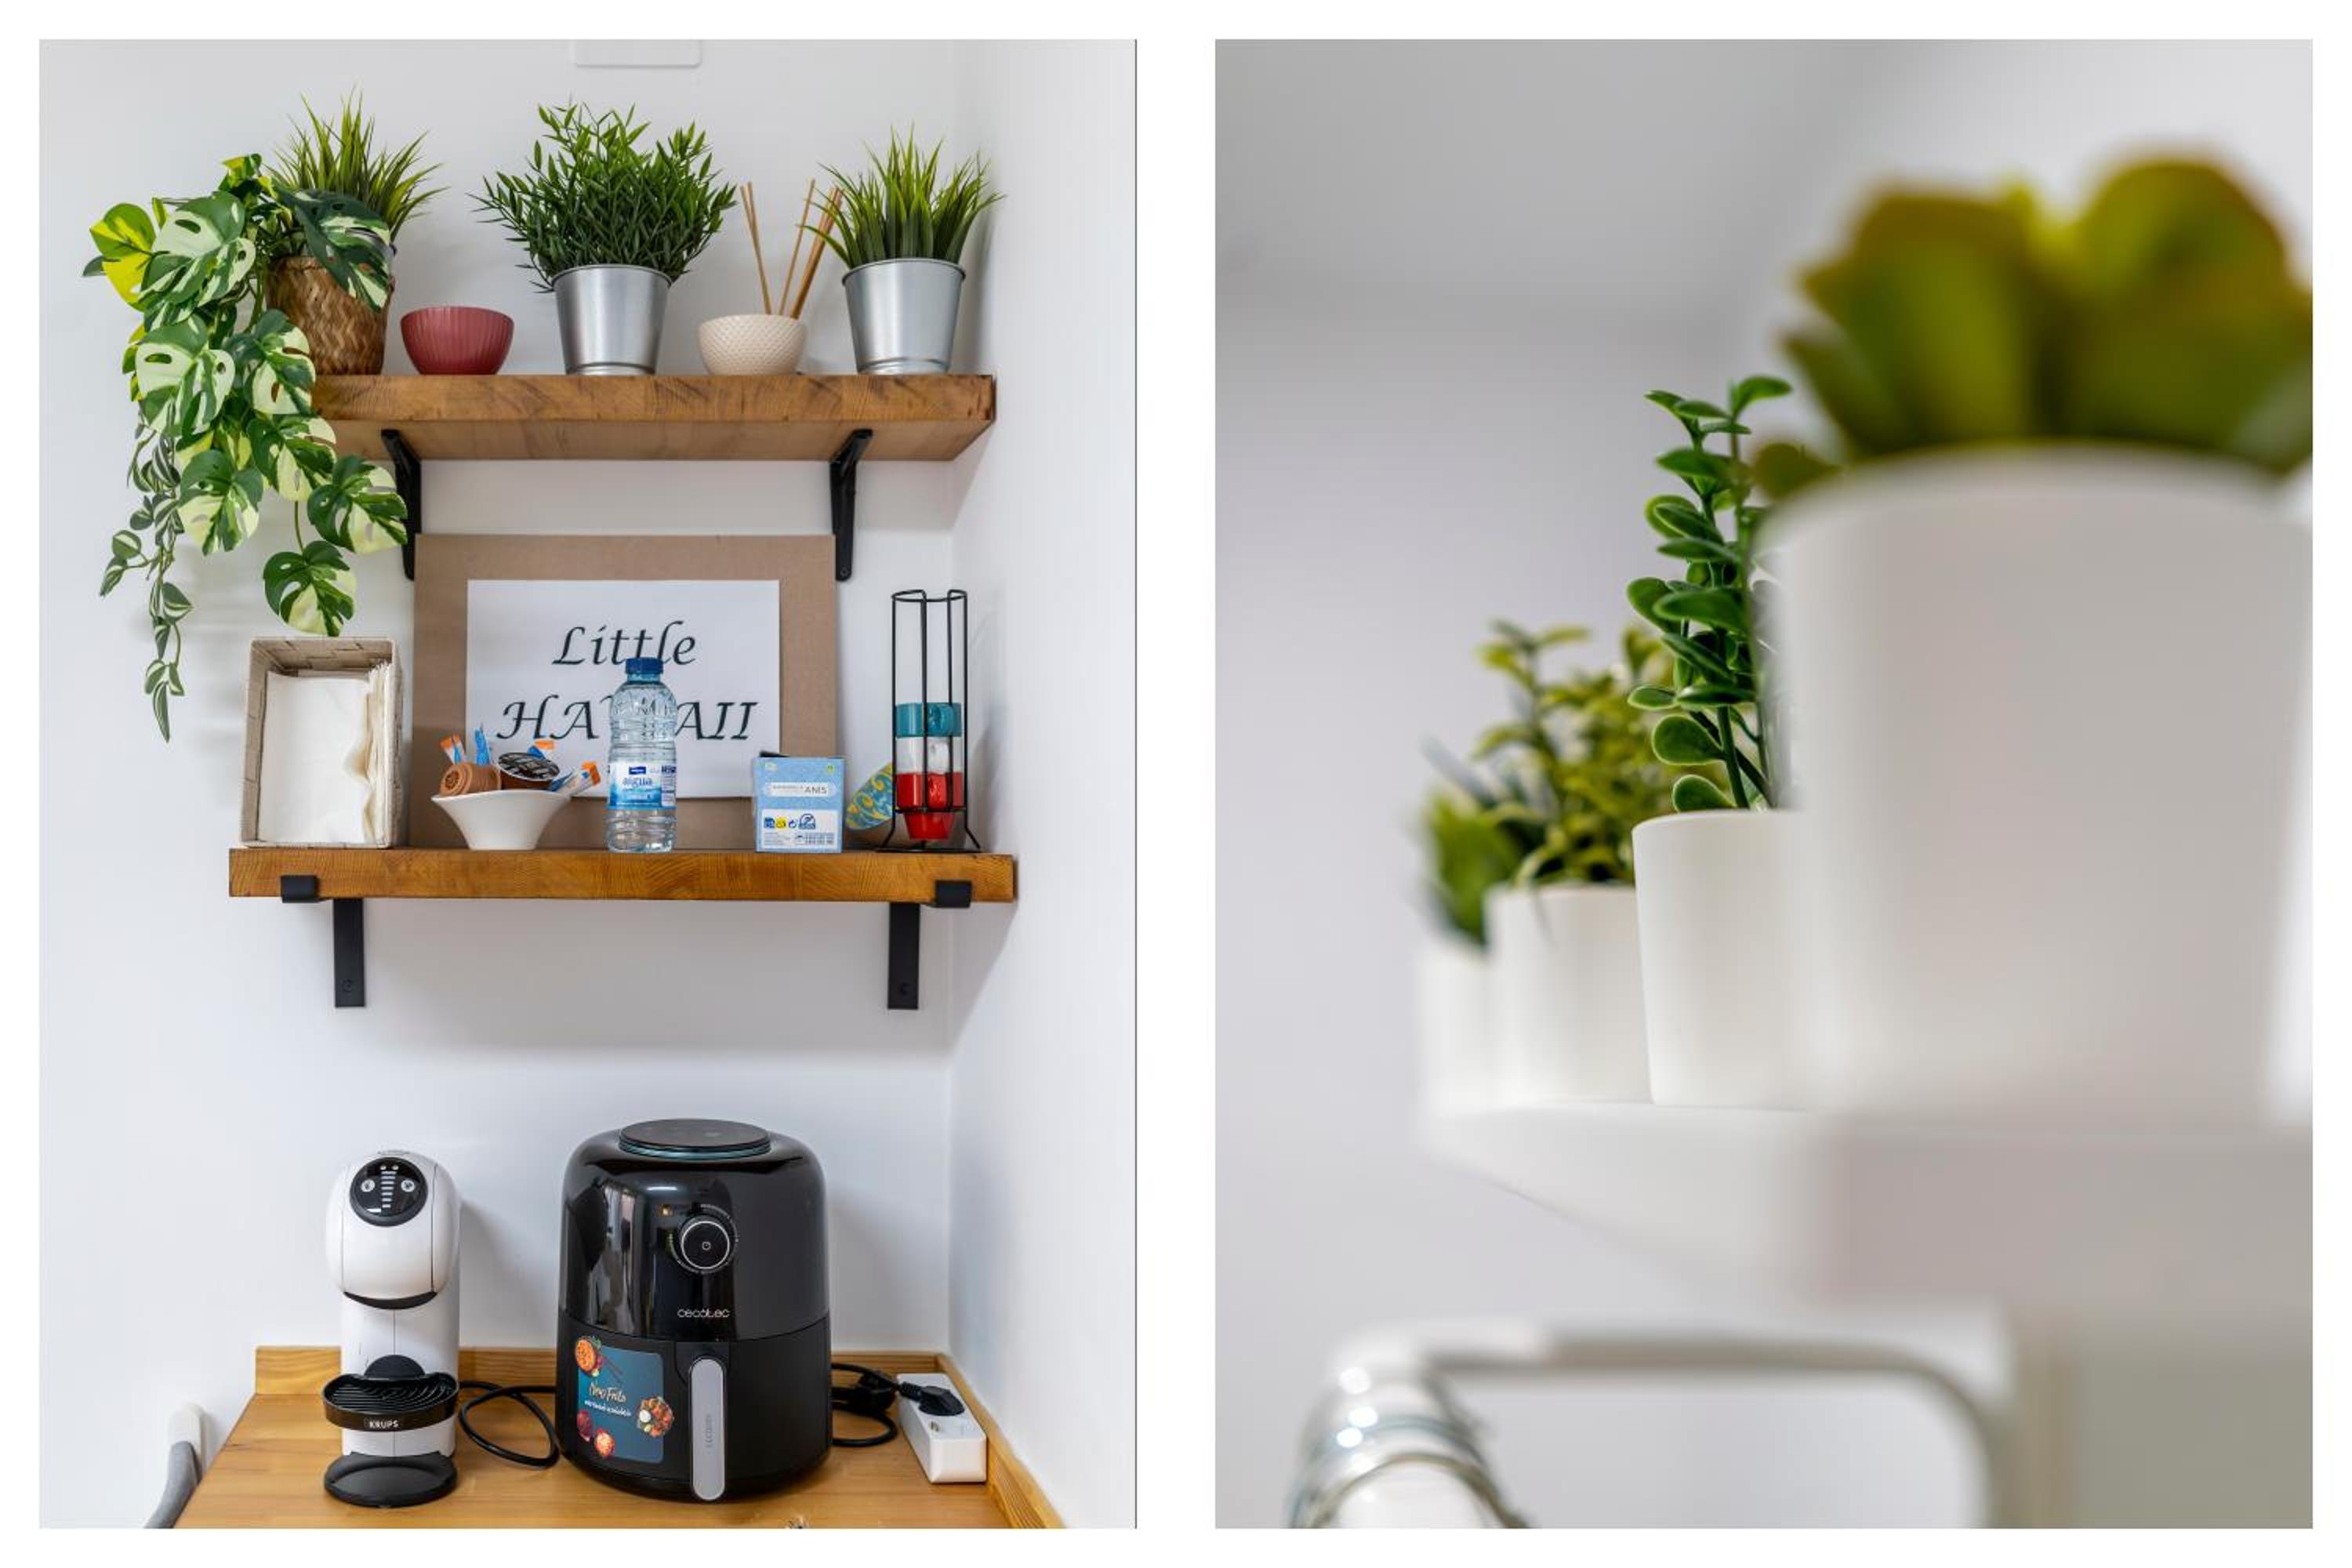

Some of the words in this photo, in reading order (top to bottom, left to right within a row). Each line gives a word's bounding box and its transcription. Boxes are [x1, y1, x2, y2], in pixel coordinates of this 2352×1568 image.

[552, 620, 698, 666] Little
[496, 694, 759, 739] HAAII
[804, 786, 828, 795] ANIS
[677, 1308, 731, 1319] cecotec
[369, 1419, 399, 1429] KRUPS
